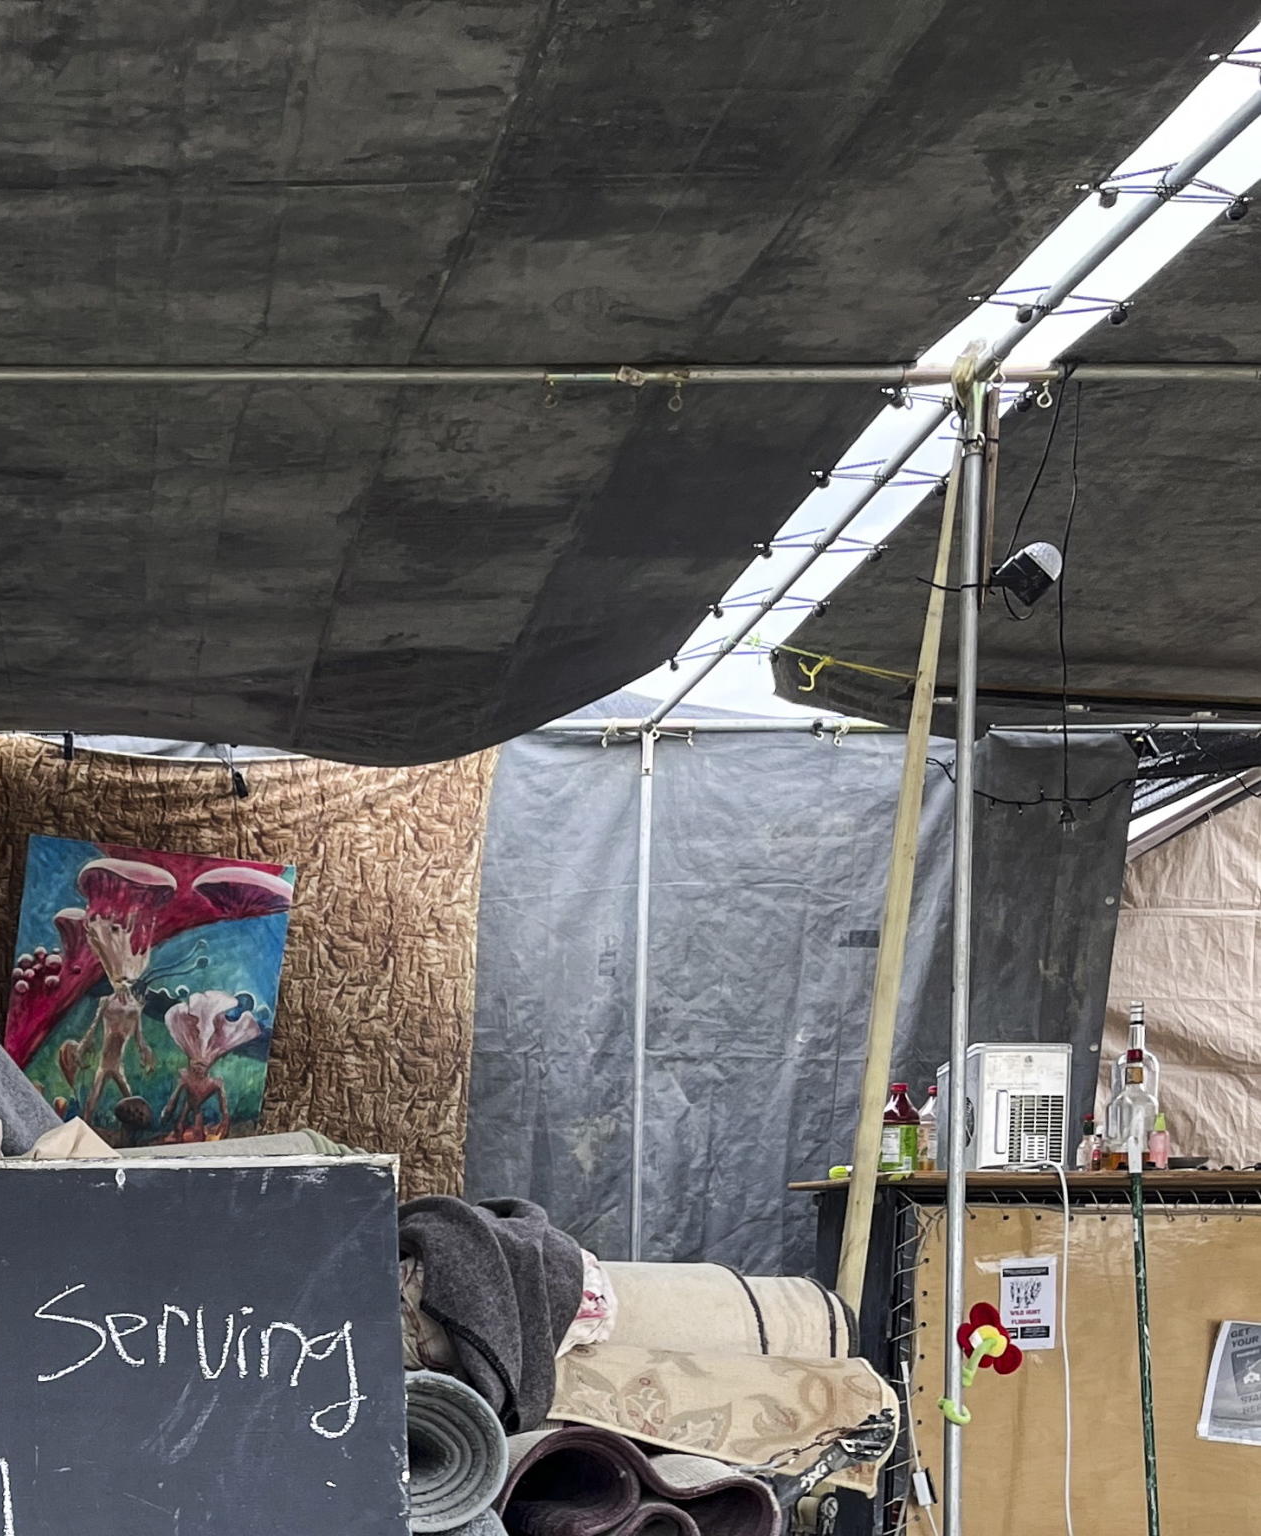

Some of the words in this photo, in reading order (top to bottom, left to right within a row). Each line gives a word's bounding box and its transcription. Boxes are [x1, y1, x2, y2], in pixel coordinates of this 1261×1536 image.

[1231, 1327, 1250, 1338] GET
[1232, 1335, 1259, 1348] YOUR
[34, 1282, 368, 1440] Serving
